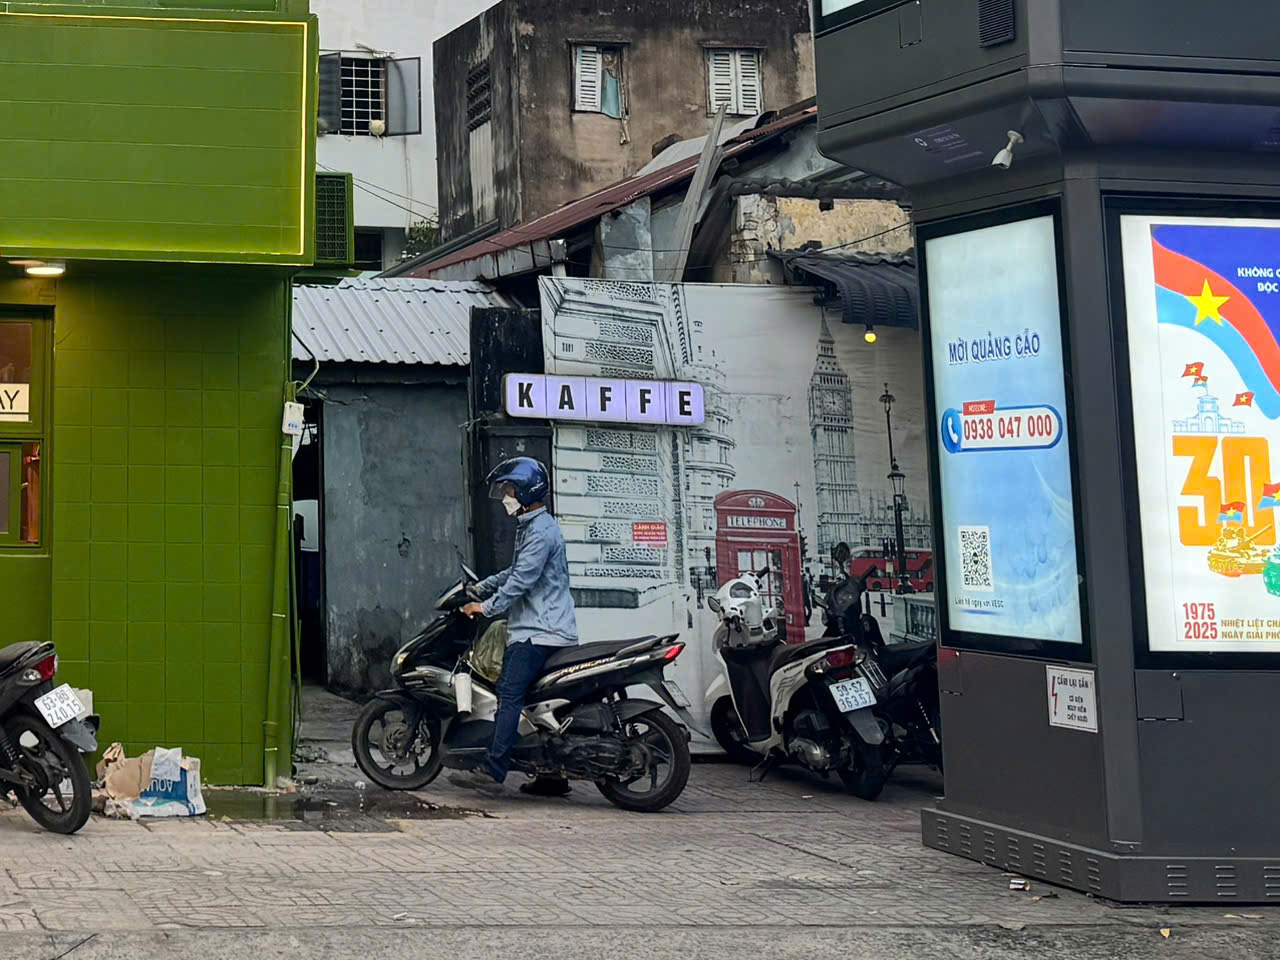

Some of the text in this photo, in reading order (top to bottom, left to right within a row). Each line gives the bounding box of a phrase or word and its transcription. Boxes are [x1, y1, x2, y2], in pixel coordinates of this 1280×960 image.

[1237, 266, 1274, 278] KHÔNG
[518, 382, 692, 416] KAFFE
[964, 414, 1052, 440] 0938 047 000
[1172, 435, 1276, 546] 30
[730, 516, 785, 528] TELEPHONE
[1182, 602, 1215, 620] 1975
[1184, 621, 1218, 640] 2025
